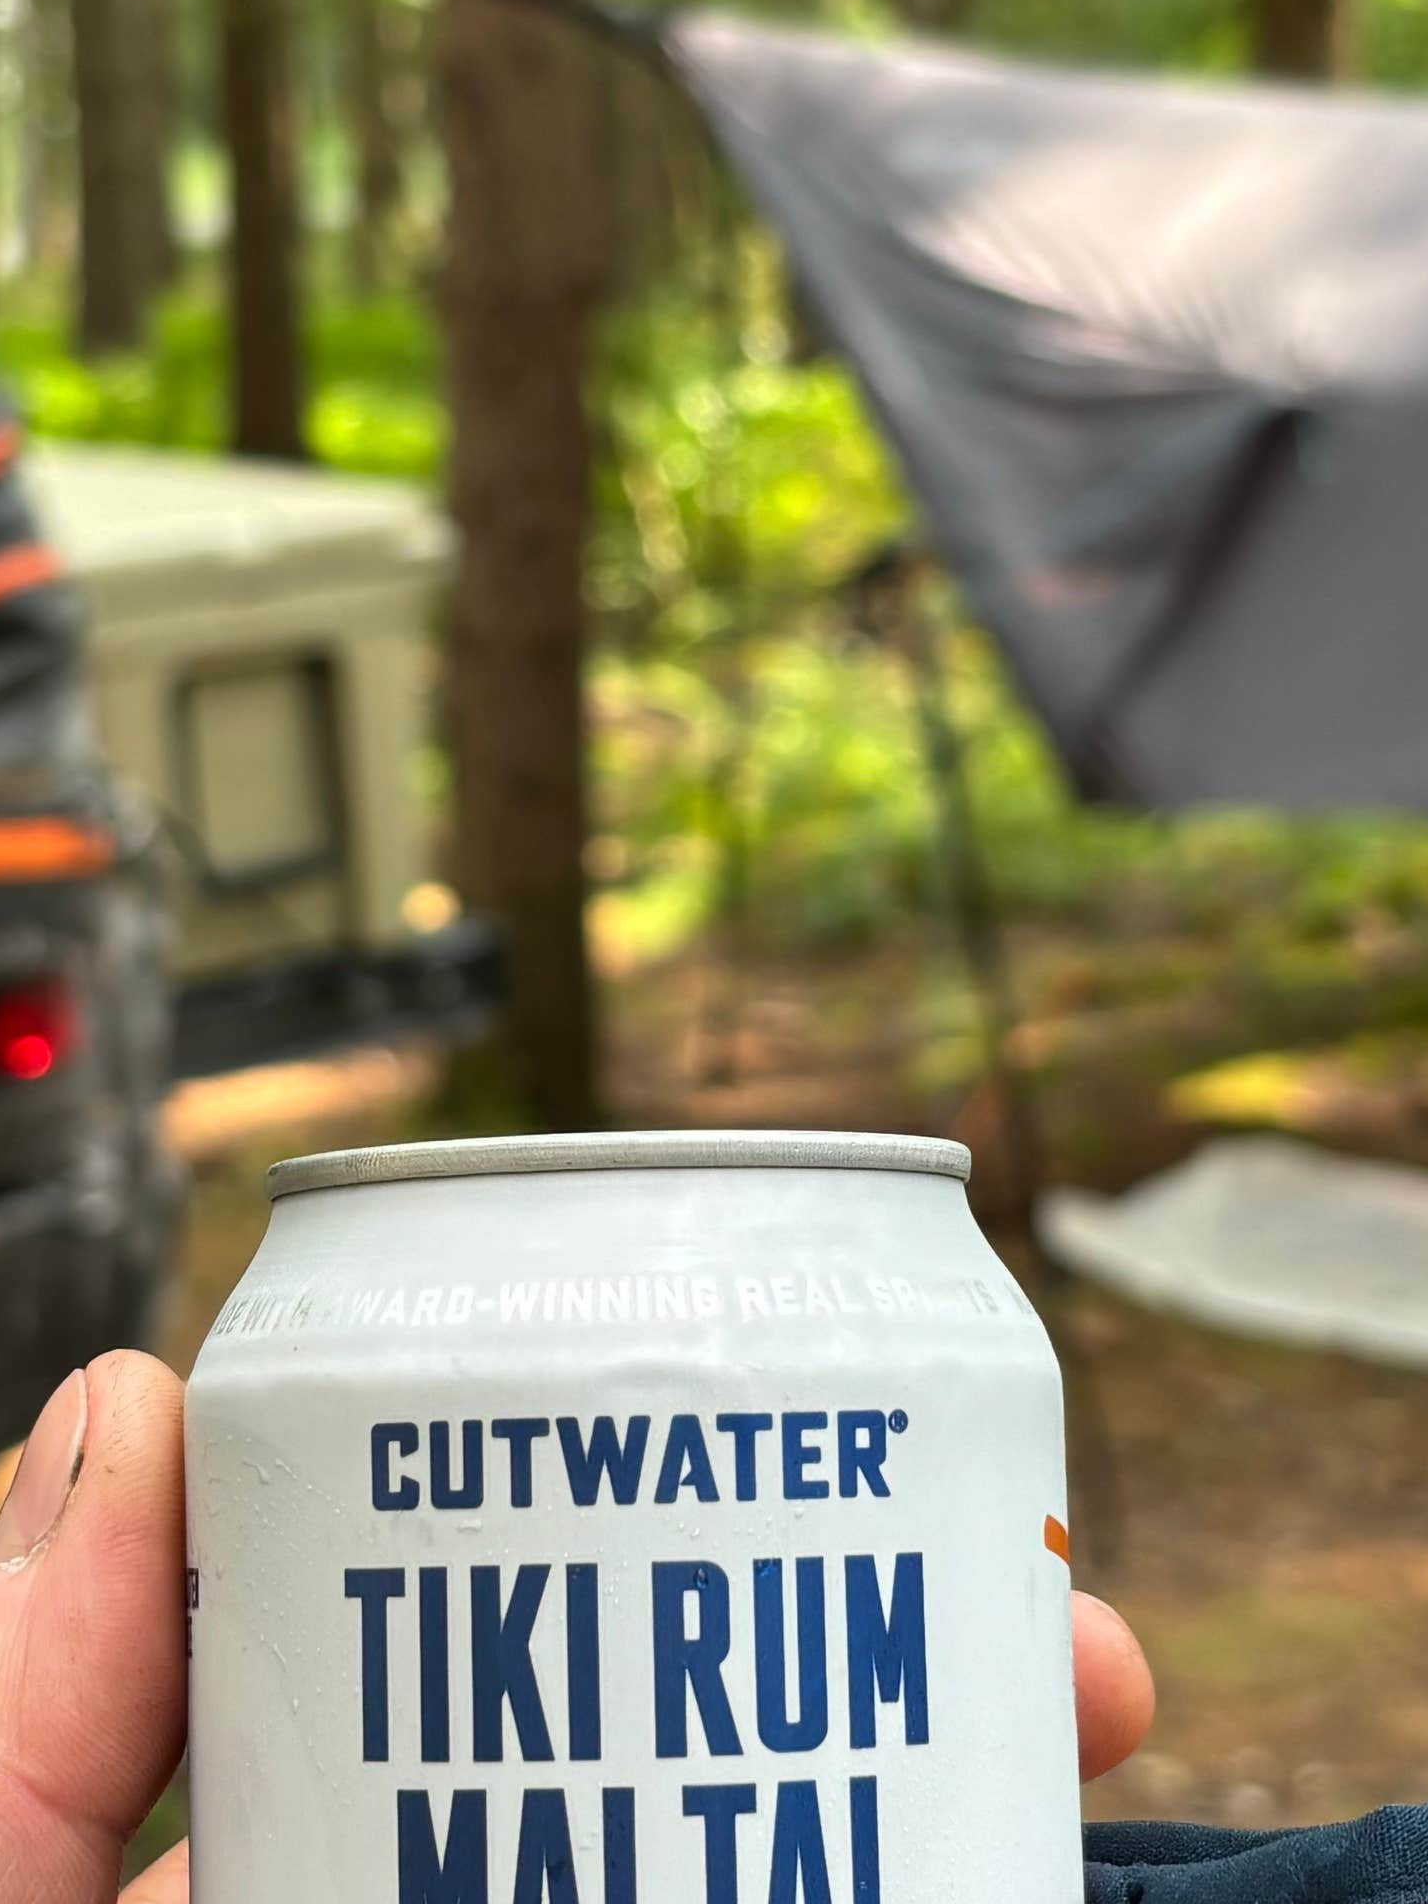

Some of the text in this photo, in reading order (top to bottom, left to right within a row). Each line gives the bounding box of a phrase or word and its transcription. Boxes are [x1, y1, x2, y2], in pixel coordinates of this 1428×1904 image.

[735, 1272, 860, 1322] REAL
[344, 1551, 930, 1763] TIKI RUM
